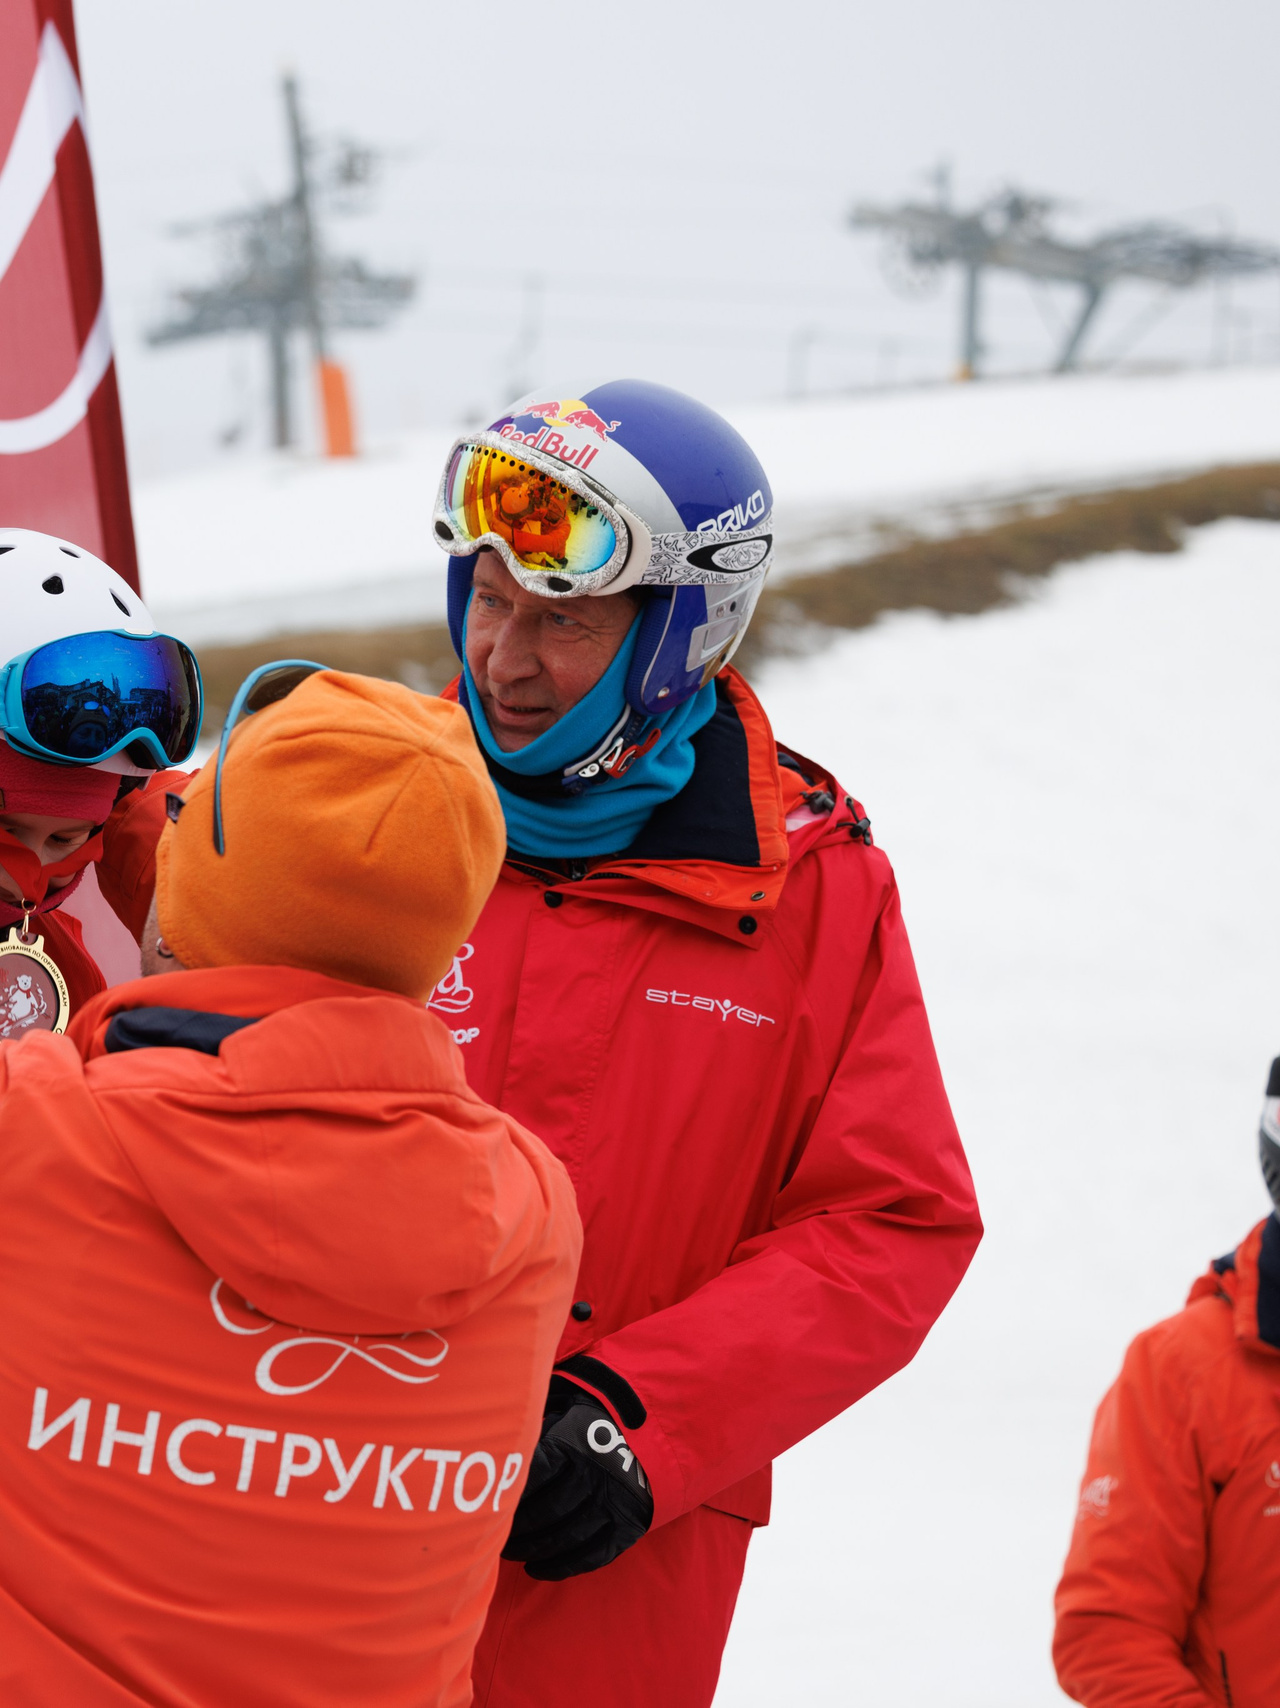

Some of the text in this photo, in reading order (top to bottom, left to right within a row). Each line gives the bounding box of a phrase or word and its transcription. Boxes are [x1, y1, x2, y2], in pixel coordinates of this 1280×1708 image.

[541, 432, 600, 470] Bull
[31, 949, 42, 958] ПО
[40, 954, 61, 980] ГОРНЫМ
[27, 1386, 523, 1514] ИНСТРУКТОР
